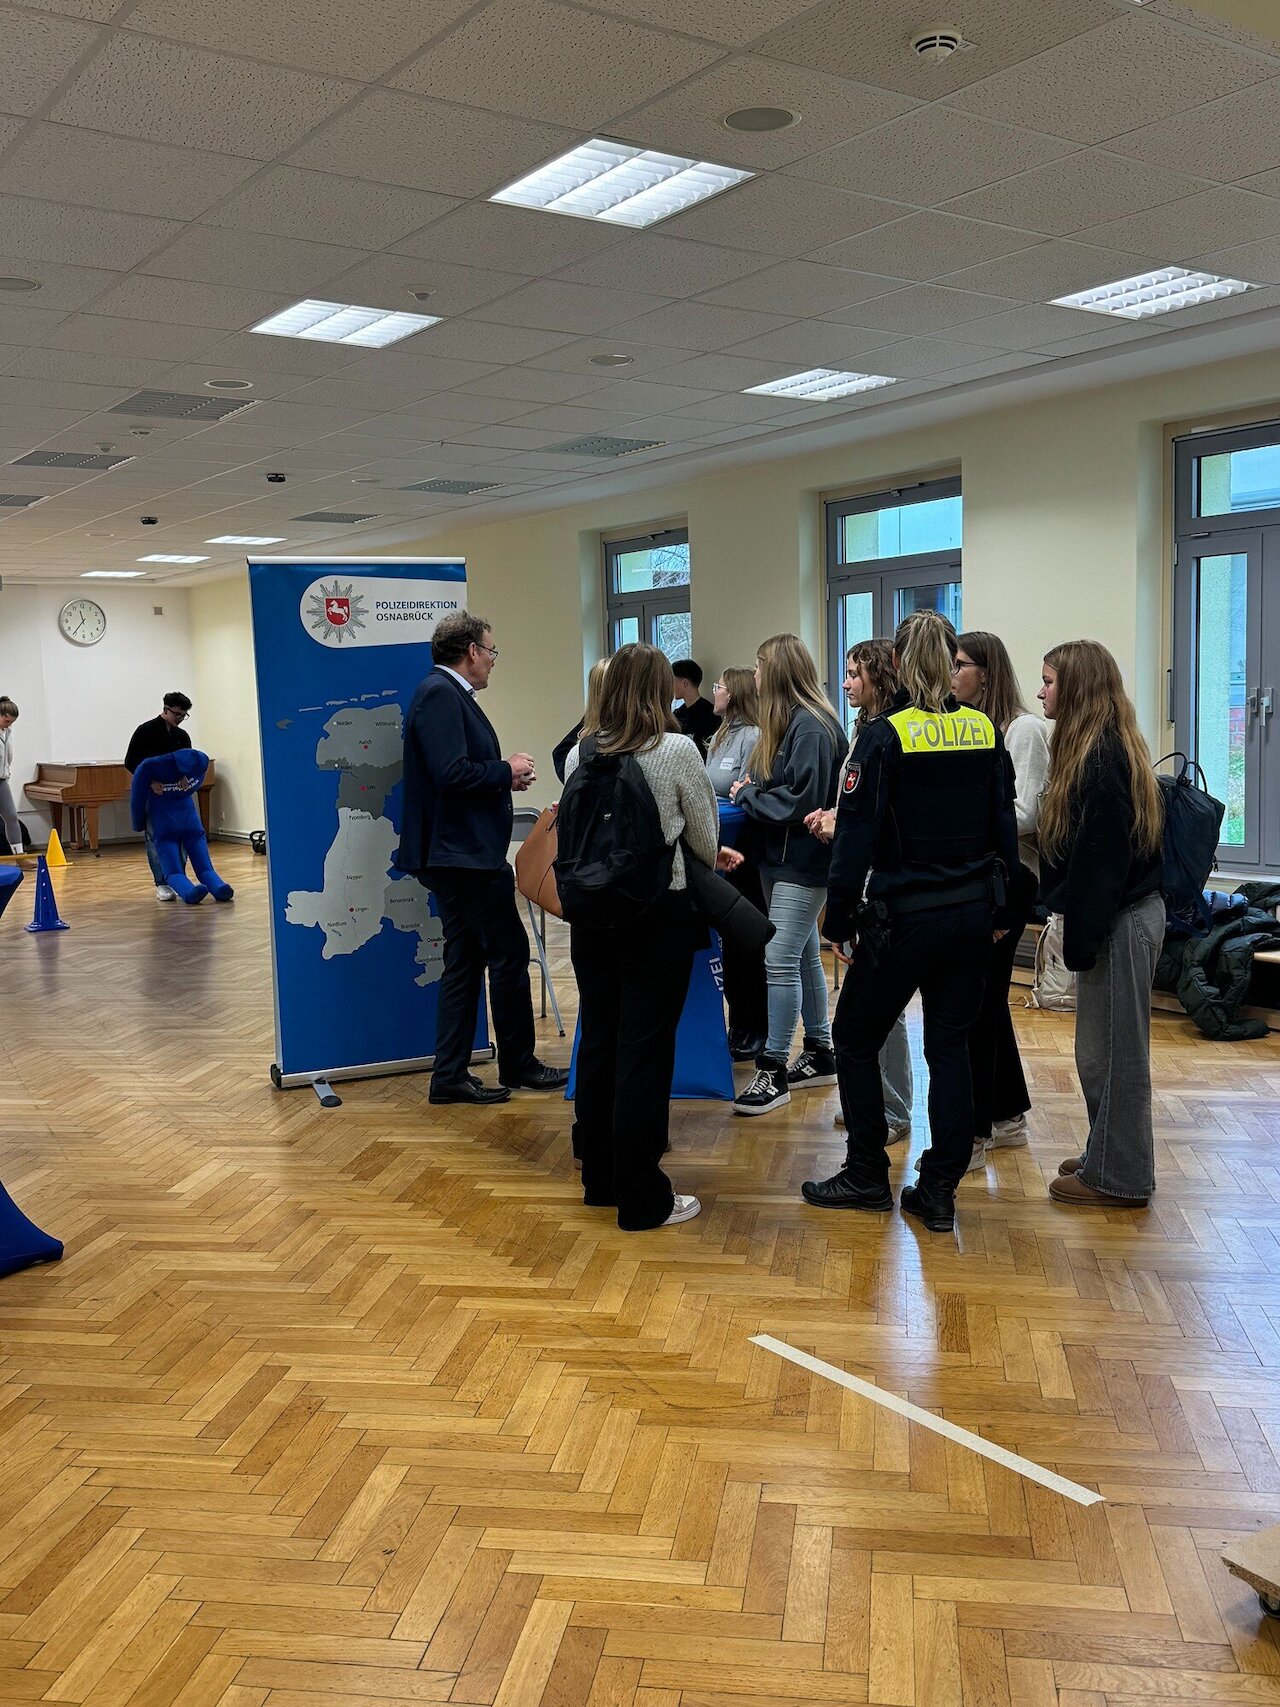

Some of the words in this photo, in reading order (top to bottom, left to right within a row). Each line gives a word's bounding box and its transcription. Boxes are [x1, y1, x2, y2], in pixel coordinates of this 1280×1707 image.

[375, 600, 458, 610] POLIZEIDIREKTION
[376, 611, 434, 621] OSNABRÜCK
[906, 717, 989, 748] POLIZEI
